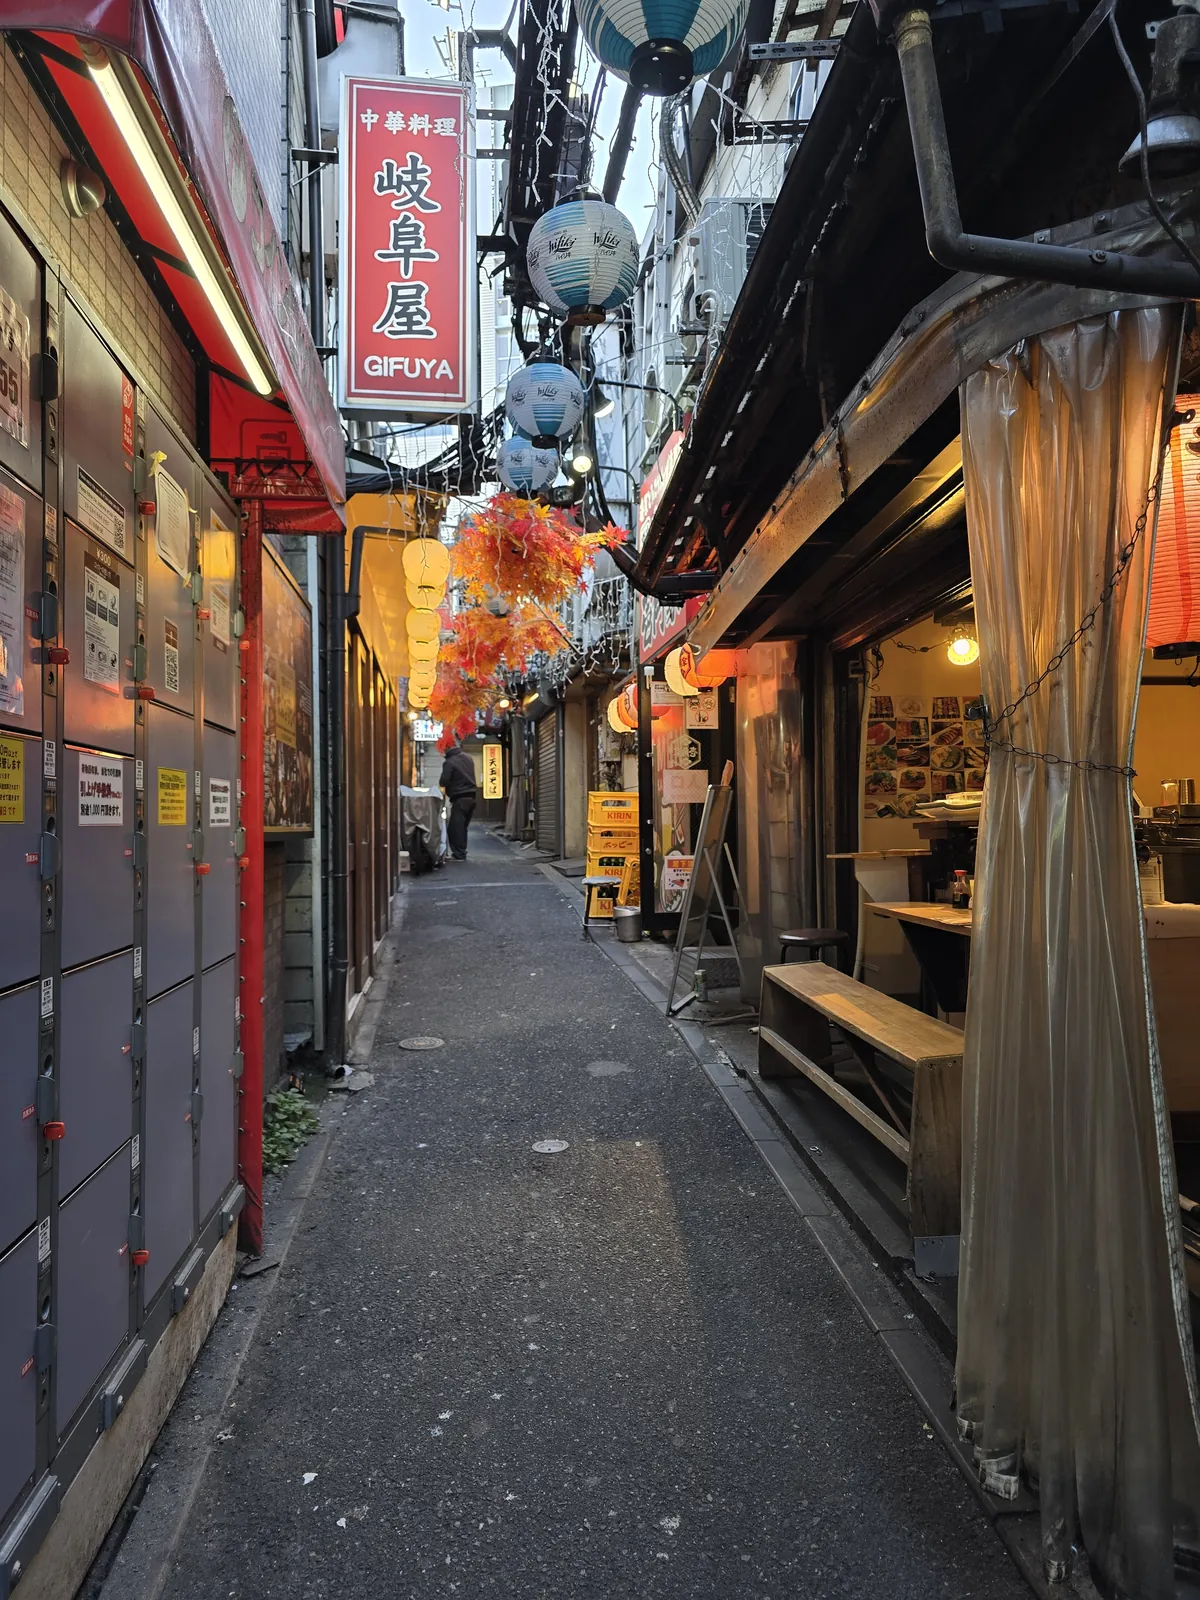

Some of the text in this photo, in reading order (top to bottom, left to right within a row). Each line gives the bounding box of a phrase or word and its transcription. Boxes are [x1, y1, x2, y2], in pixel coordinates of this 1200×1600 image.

[359, 108, 459, 137] 中華料理
[372, 150, 441, 341] 岐阜屋
[363, 354, 454, 381] GIFUYA
[96, 547, 111, 567] ¥300
[607, 812, 632, 820] KIRIN
[603, 841, 633, 849] ホッピー
